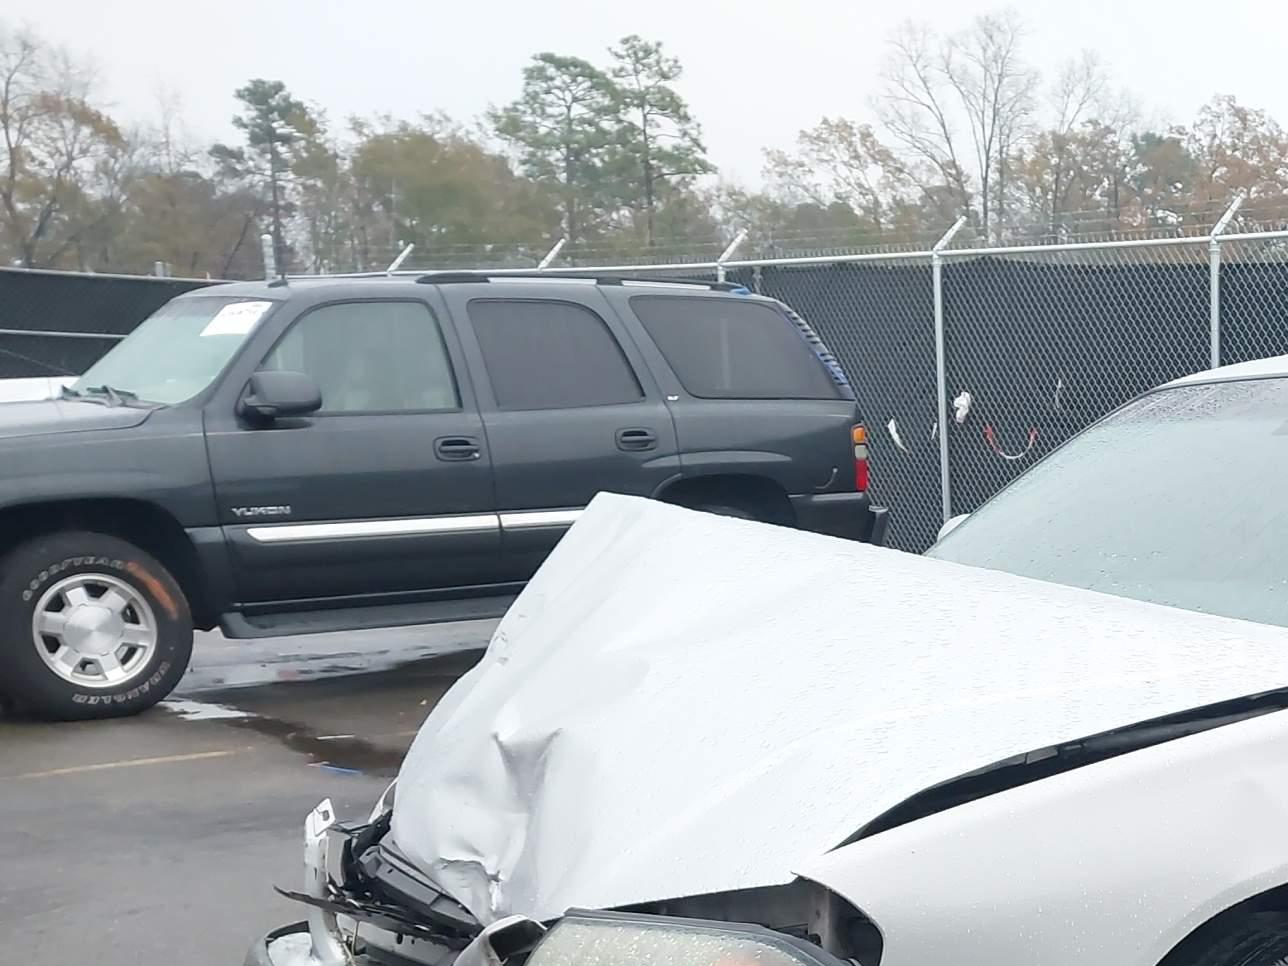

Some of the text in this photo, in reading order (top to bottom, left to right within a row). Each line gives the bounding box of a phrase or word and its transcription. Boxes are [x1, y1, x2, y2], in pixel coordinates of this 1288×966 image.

[231, 505, 291, 516] YUKON
[22, 556, 124, 601] GOODYEAR
[71, 661, 171, 705] WRANGLER
